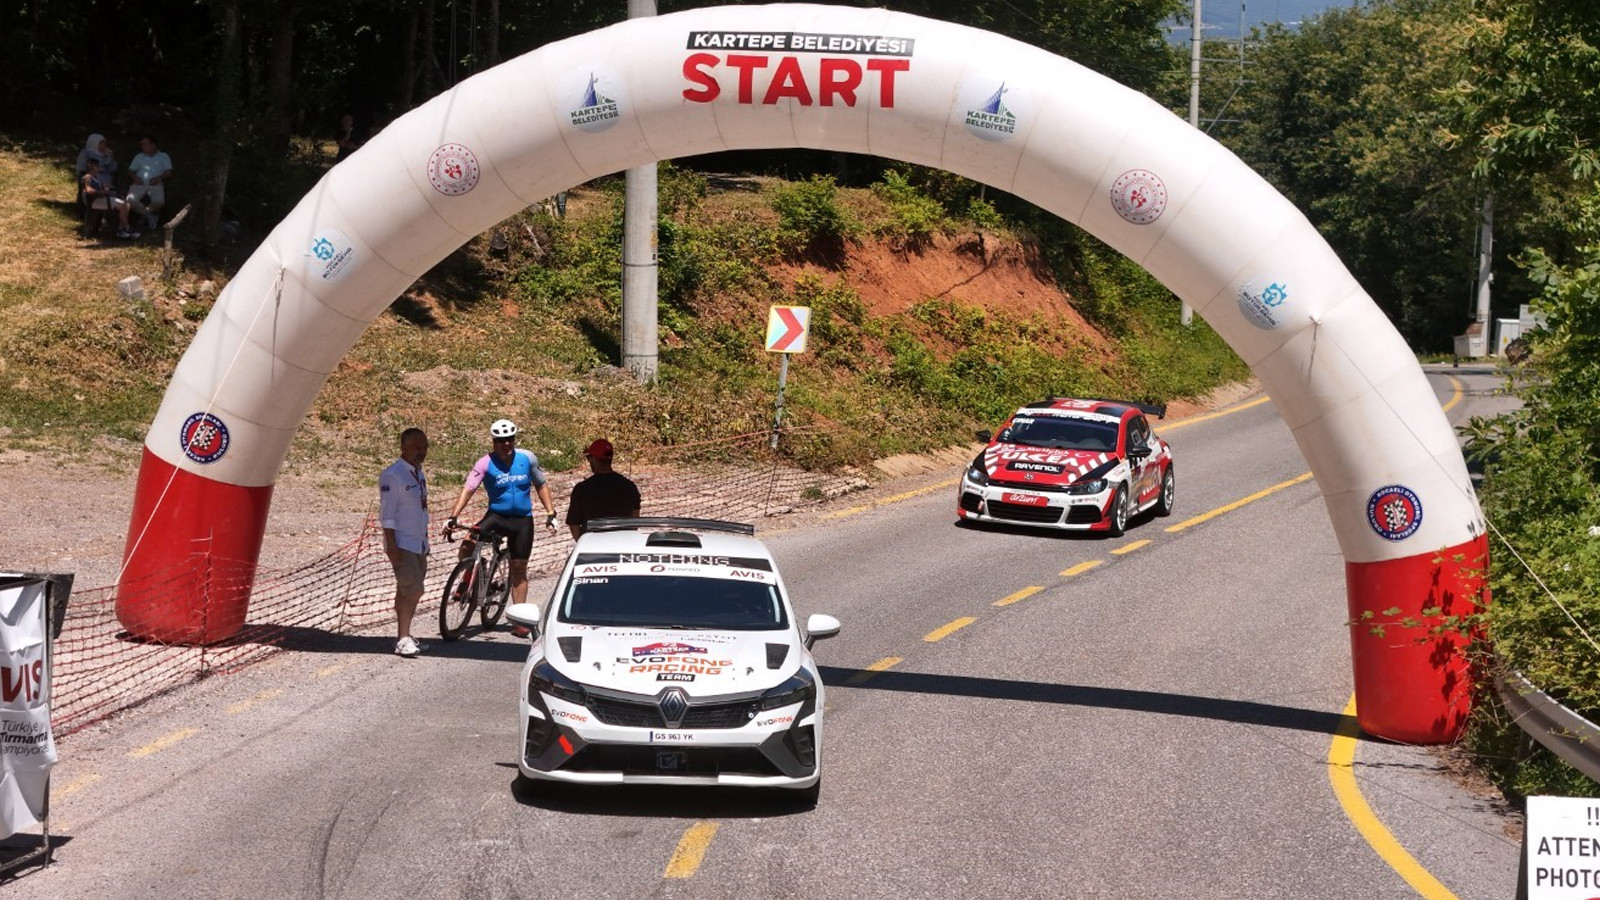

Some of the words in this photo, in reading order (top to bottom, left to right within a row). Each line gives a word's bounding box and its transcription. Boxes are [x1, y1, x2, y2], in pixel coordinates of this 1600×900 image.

[694, 33, 786, 49] KARTEPE
[682, 53, 910, 108] START
[571, 104, 617, 118] KARTEPE
[967, 110, 1015, 126] KARTEPE
[620, 553, 730, 566] NOTHING
[582, 565, 618, 573] AVIS
[730, 570, 765, 579] AVIS
[573, 577, 609, 585] Sinan
[616, 656, 734, 667] EVOFONG
[629, 664, 722, 675] RACING
[660, 673, 693, 681] TERM
[2, 720, 39, 735] Türkiye
